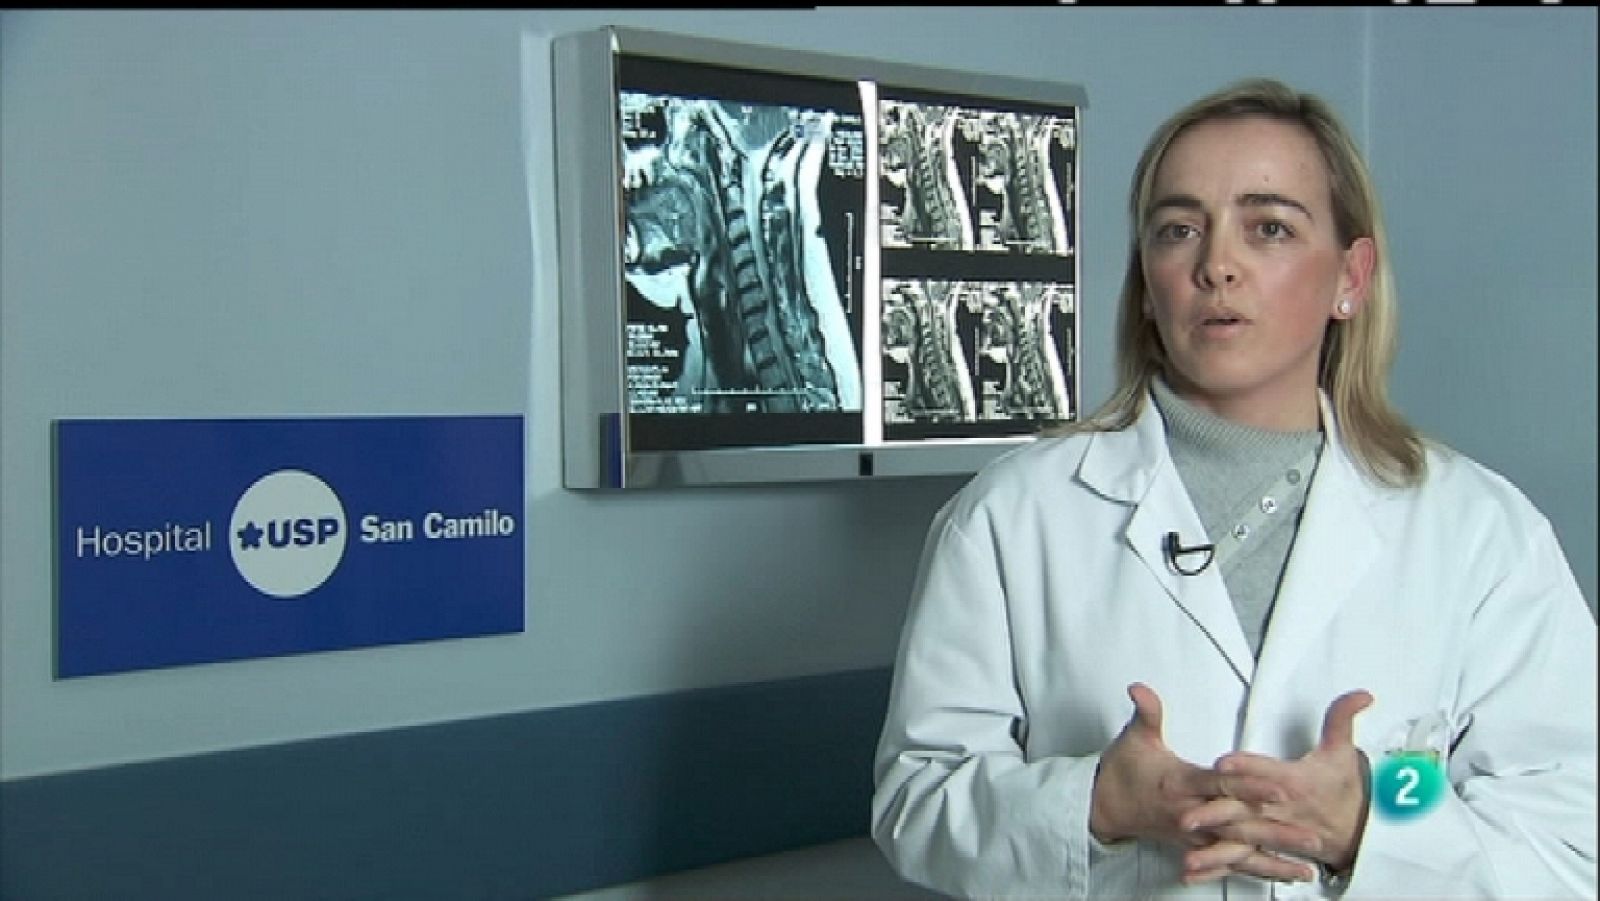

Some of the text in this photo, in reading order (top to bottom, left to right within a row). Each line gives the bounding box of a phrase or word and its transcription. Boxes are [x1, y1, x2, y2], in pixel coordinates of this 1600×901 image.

[76, 508, 515, 561] Hospital USP San Camilo
